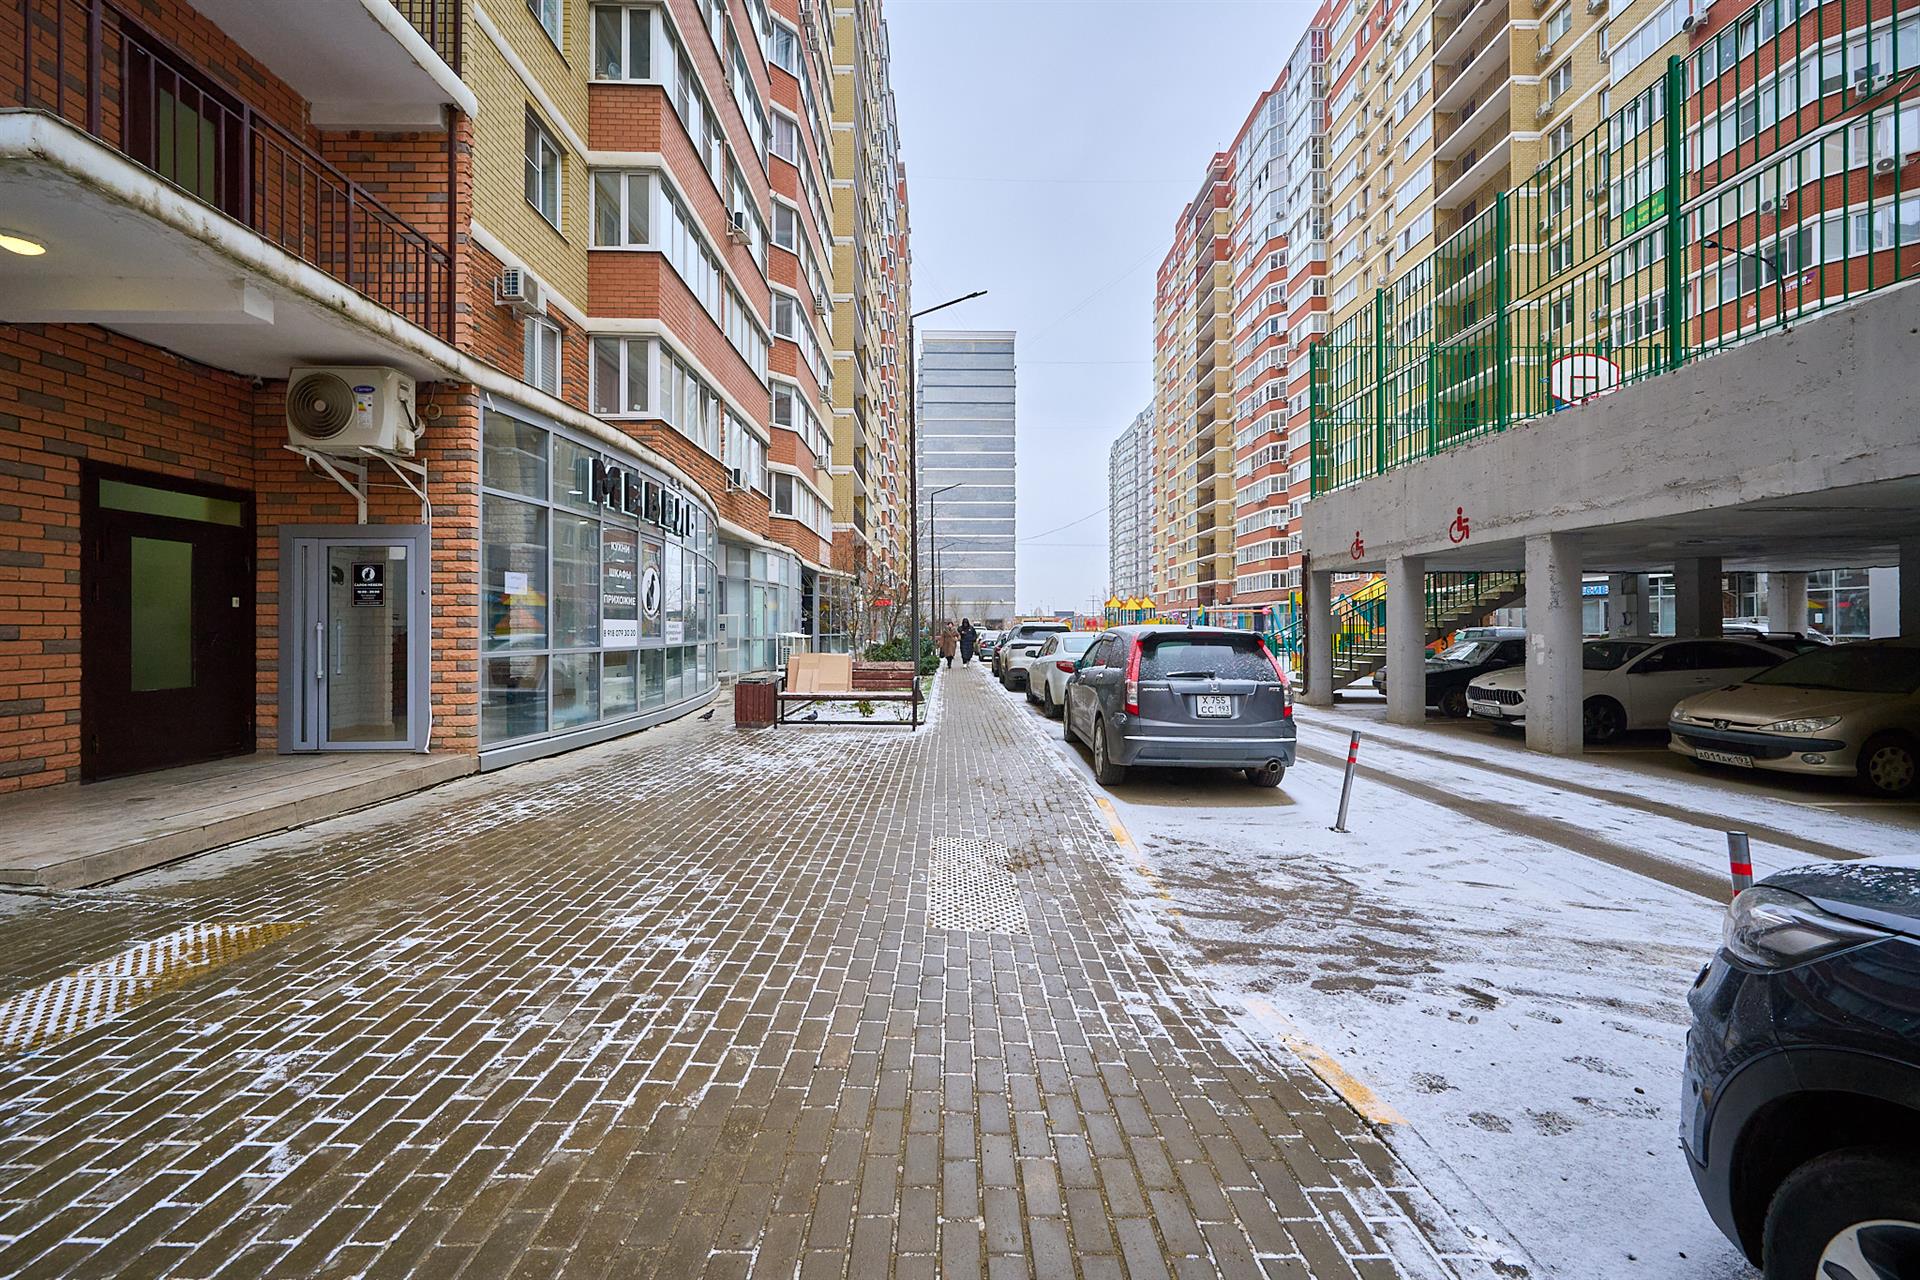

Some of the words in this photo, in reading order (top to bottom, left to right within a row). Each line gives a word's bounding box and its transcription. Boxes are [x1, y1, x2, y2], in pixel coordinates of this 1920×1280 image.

[588, 457, 696, 537] МЕБЕЛЬ
[610, 541, 630, 554] КУХНИ
[608, 567, 632, 580] ШКАФЫ
[603, 594, 636, 606] ПРИХОЖИЕ
[1211, 696, 1226, 704] 755
